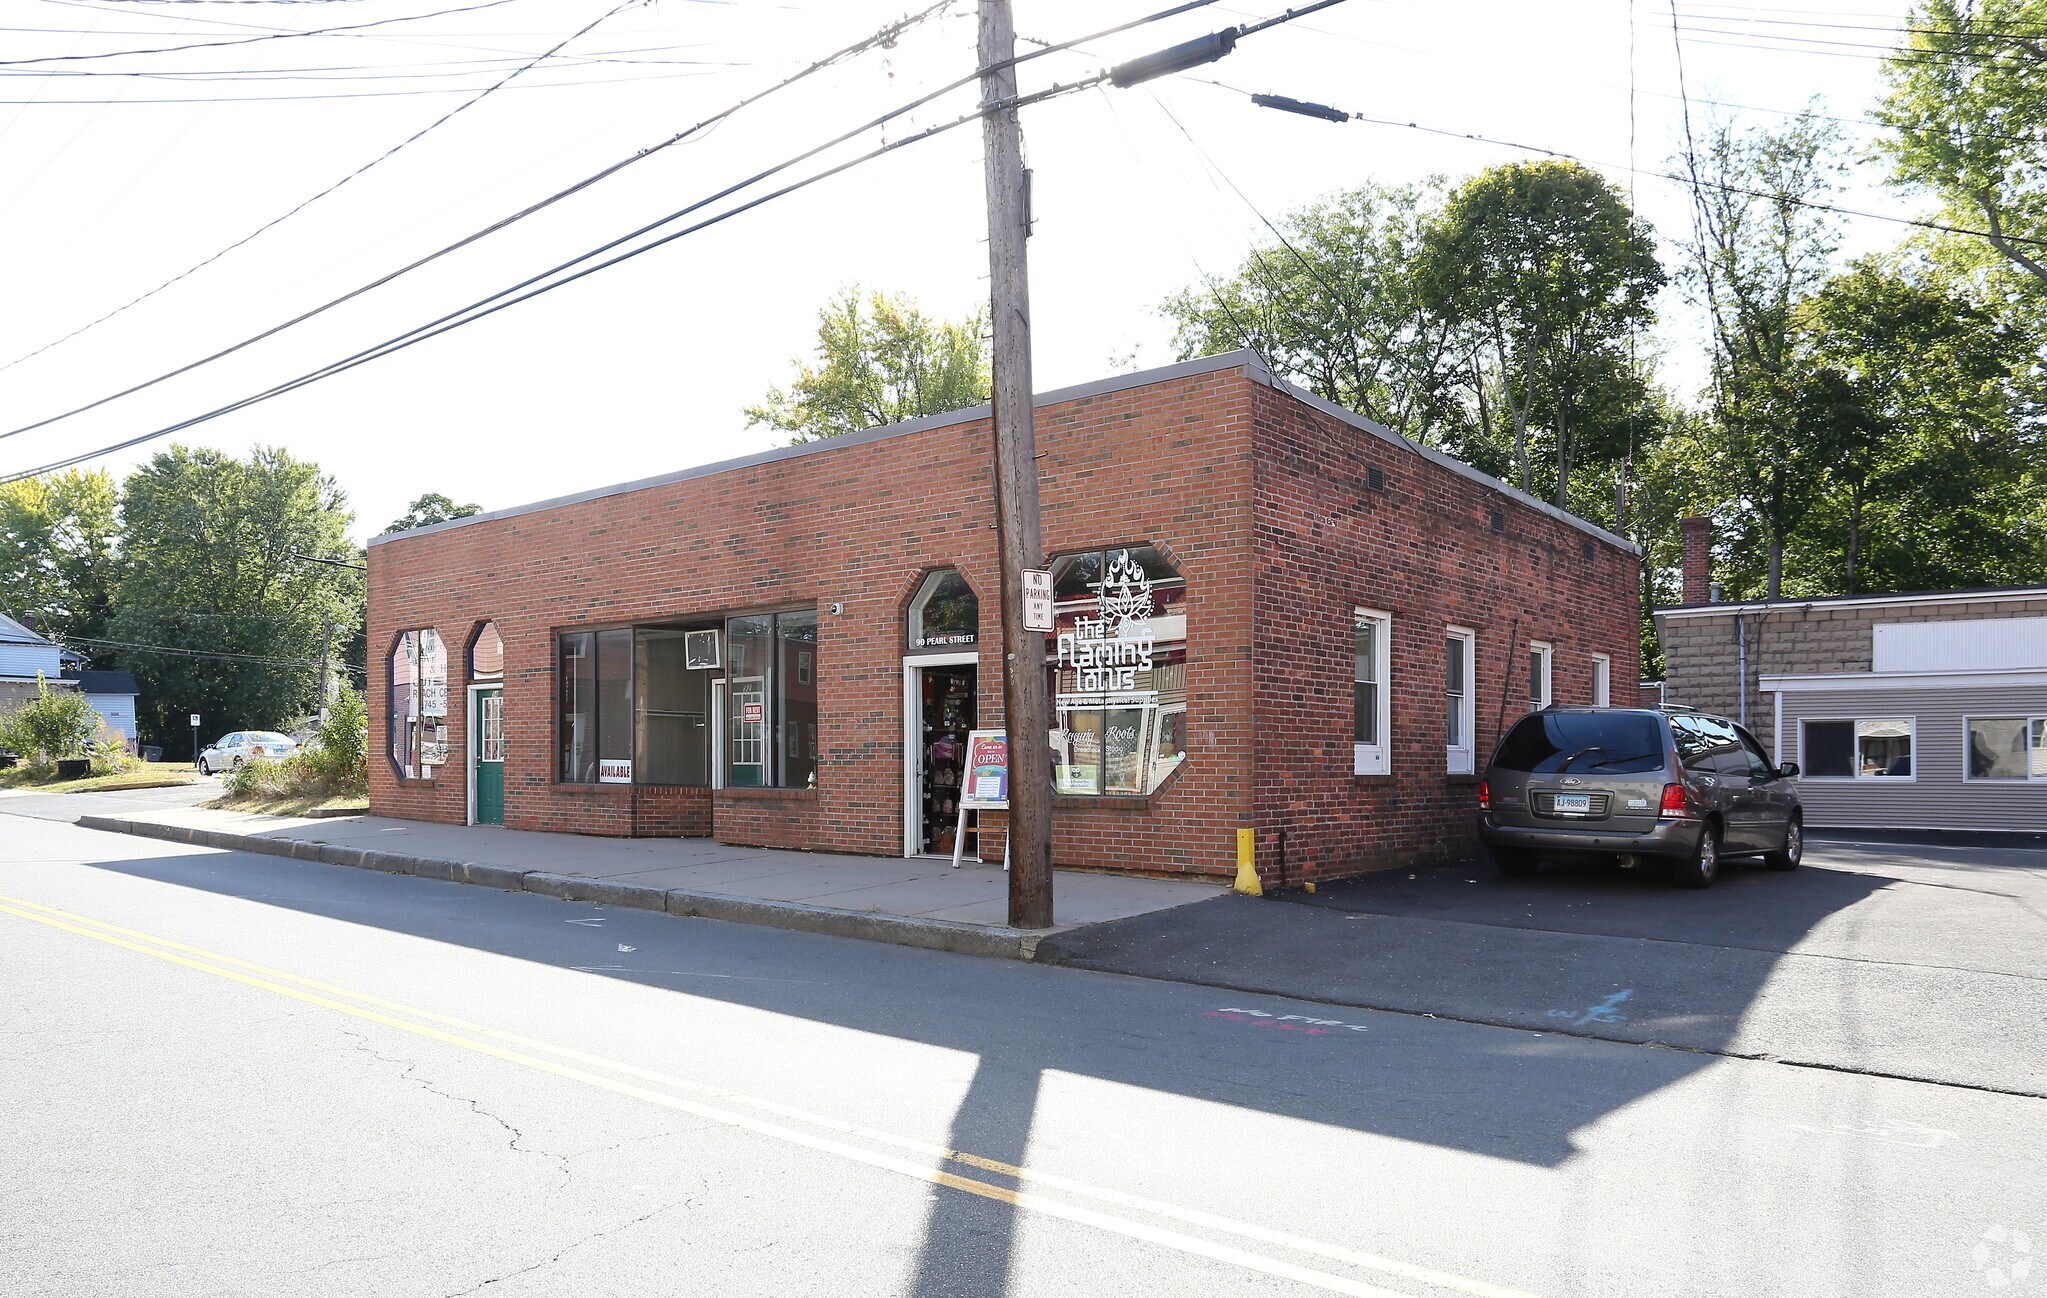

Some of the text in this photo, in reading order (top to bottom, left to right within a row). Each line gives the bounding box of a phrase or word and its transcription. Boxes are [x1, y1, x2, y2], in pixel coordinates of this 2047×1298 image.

[1032, 574, 1042, 585] NO
[1026, 588, 1050, 600] PARKING
[1033, 602, 1043, 611] ANY
[1033, 612, 1044, 621] TIME
[1074, 616, 1106, 639] the
[915, 634, 975, 647] 90 PEARL STREET
[412, 688, 436, 698] RACH
[1056, 698, 1069, 706] New
[1070, 698, 1083, 706] Age
[1088, 696, 1129, 706] Metaphysical
[1131, 695, 1159, 704] Supplies
[1104, 725, 1137, 741] Roots
[977, 753, 1005, 764] OPEN
[600, 765, 630, 778] AVAILABLE
